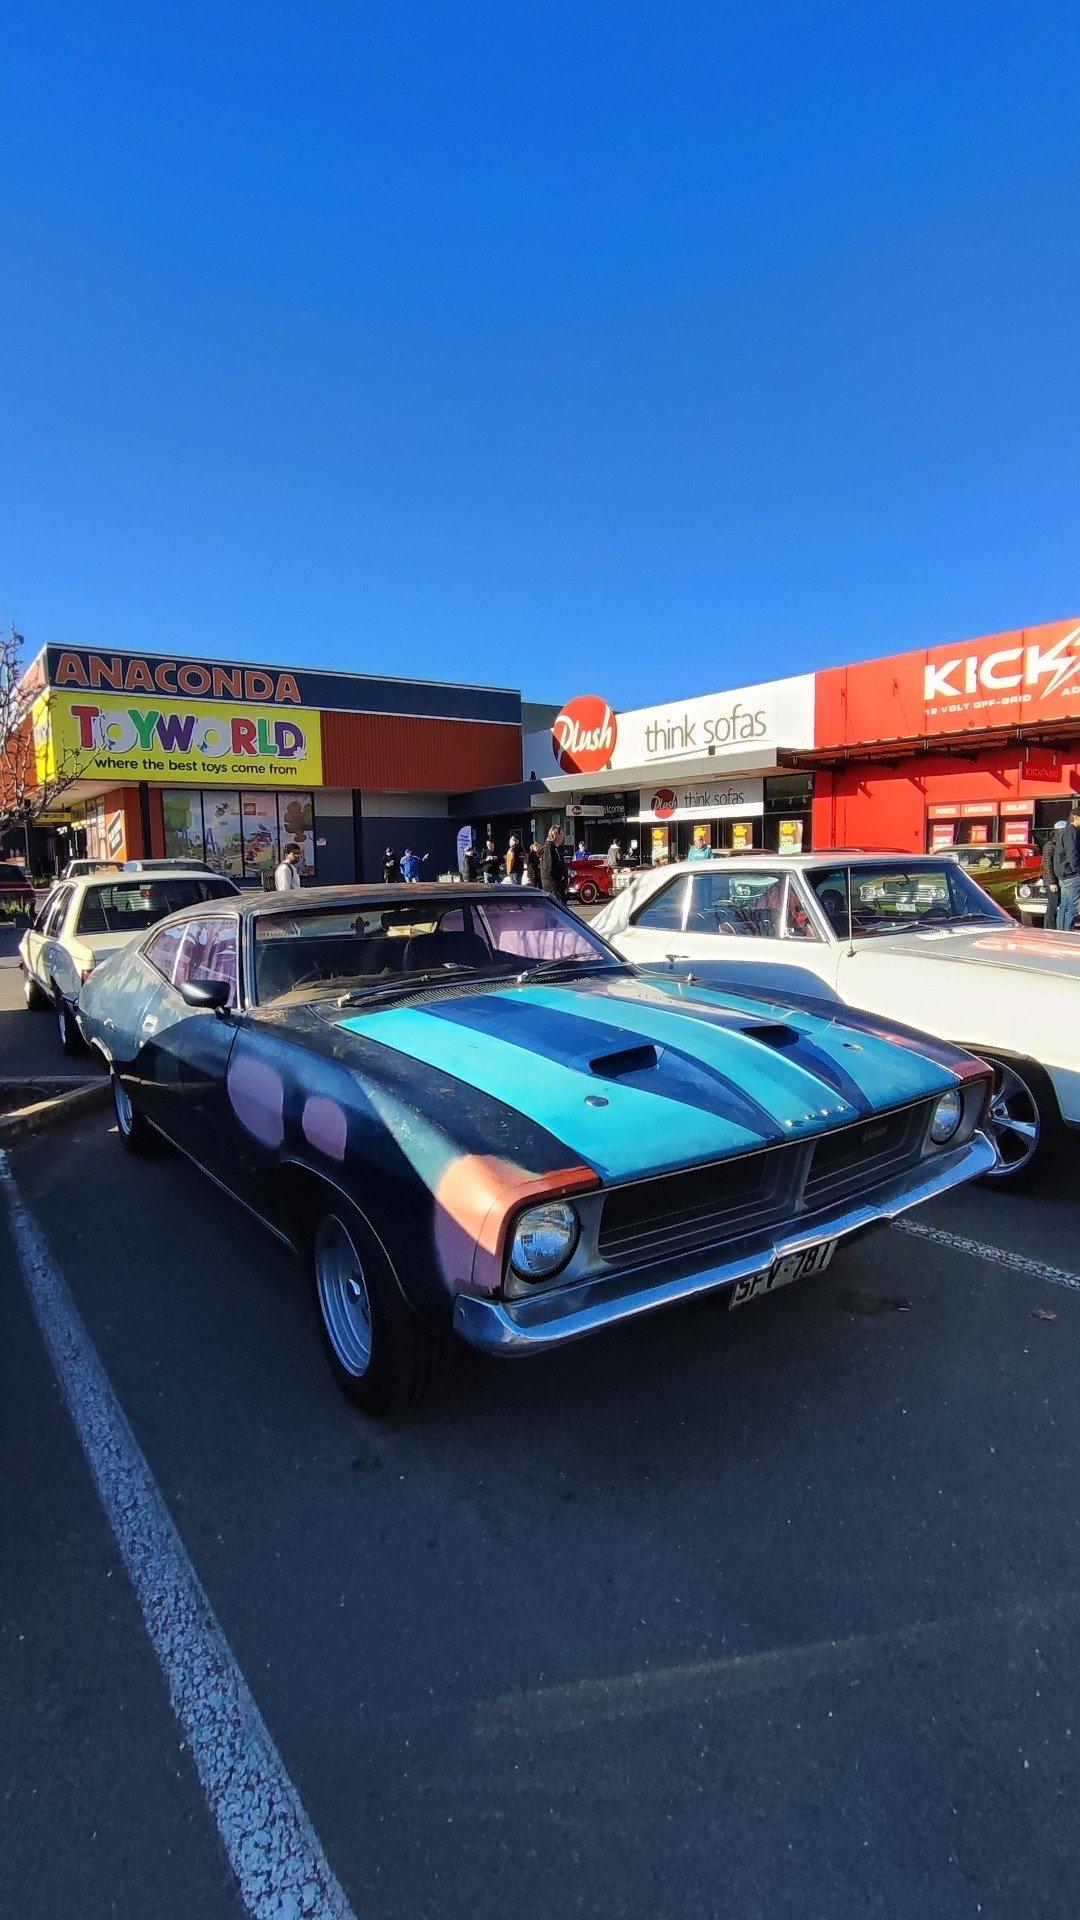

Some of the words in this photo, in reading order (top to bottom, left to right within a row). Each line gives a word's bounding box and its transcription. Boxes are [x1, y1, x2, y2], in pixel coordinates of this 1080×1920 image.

[55, 652, 302, 703] ANACONDA
[941, 702, 970, 714] VOLT
[973, 693, 1033, 709] OFF-GRID
[70, 705, 307, 761] TOYWORLD
[554, 702, 612, 764] Plush
[645, 715, 696, 753] think
[703, 703, 767, 744] sofas
[95, 757, 138, 770] where
[142, 758, 165, 771] the
[168, 759, 198, 772] best
[201, 761, 228, 775] toys
[231, 763, 266, 774] come
[269, 763, 298, 776] from
[651, 794, 678, 812] Plush
[684, 790, 712, 808] think
[714, 788, 745, 806] sofas
[603, 805, 625, 814] elcome
